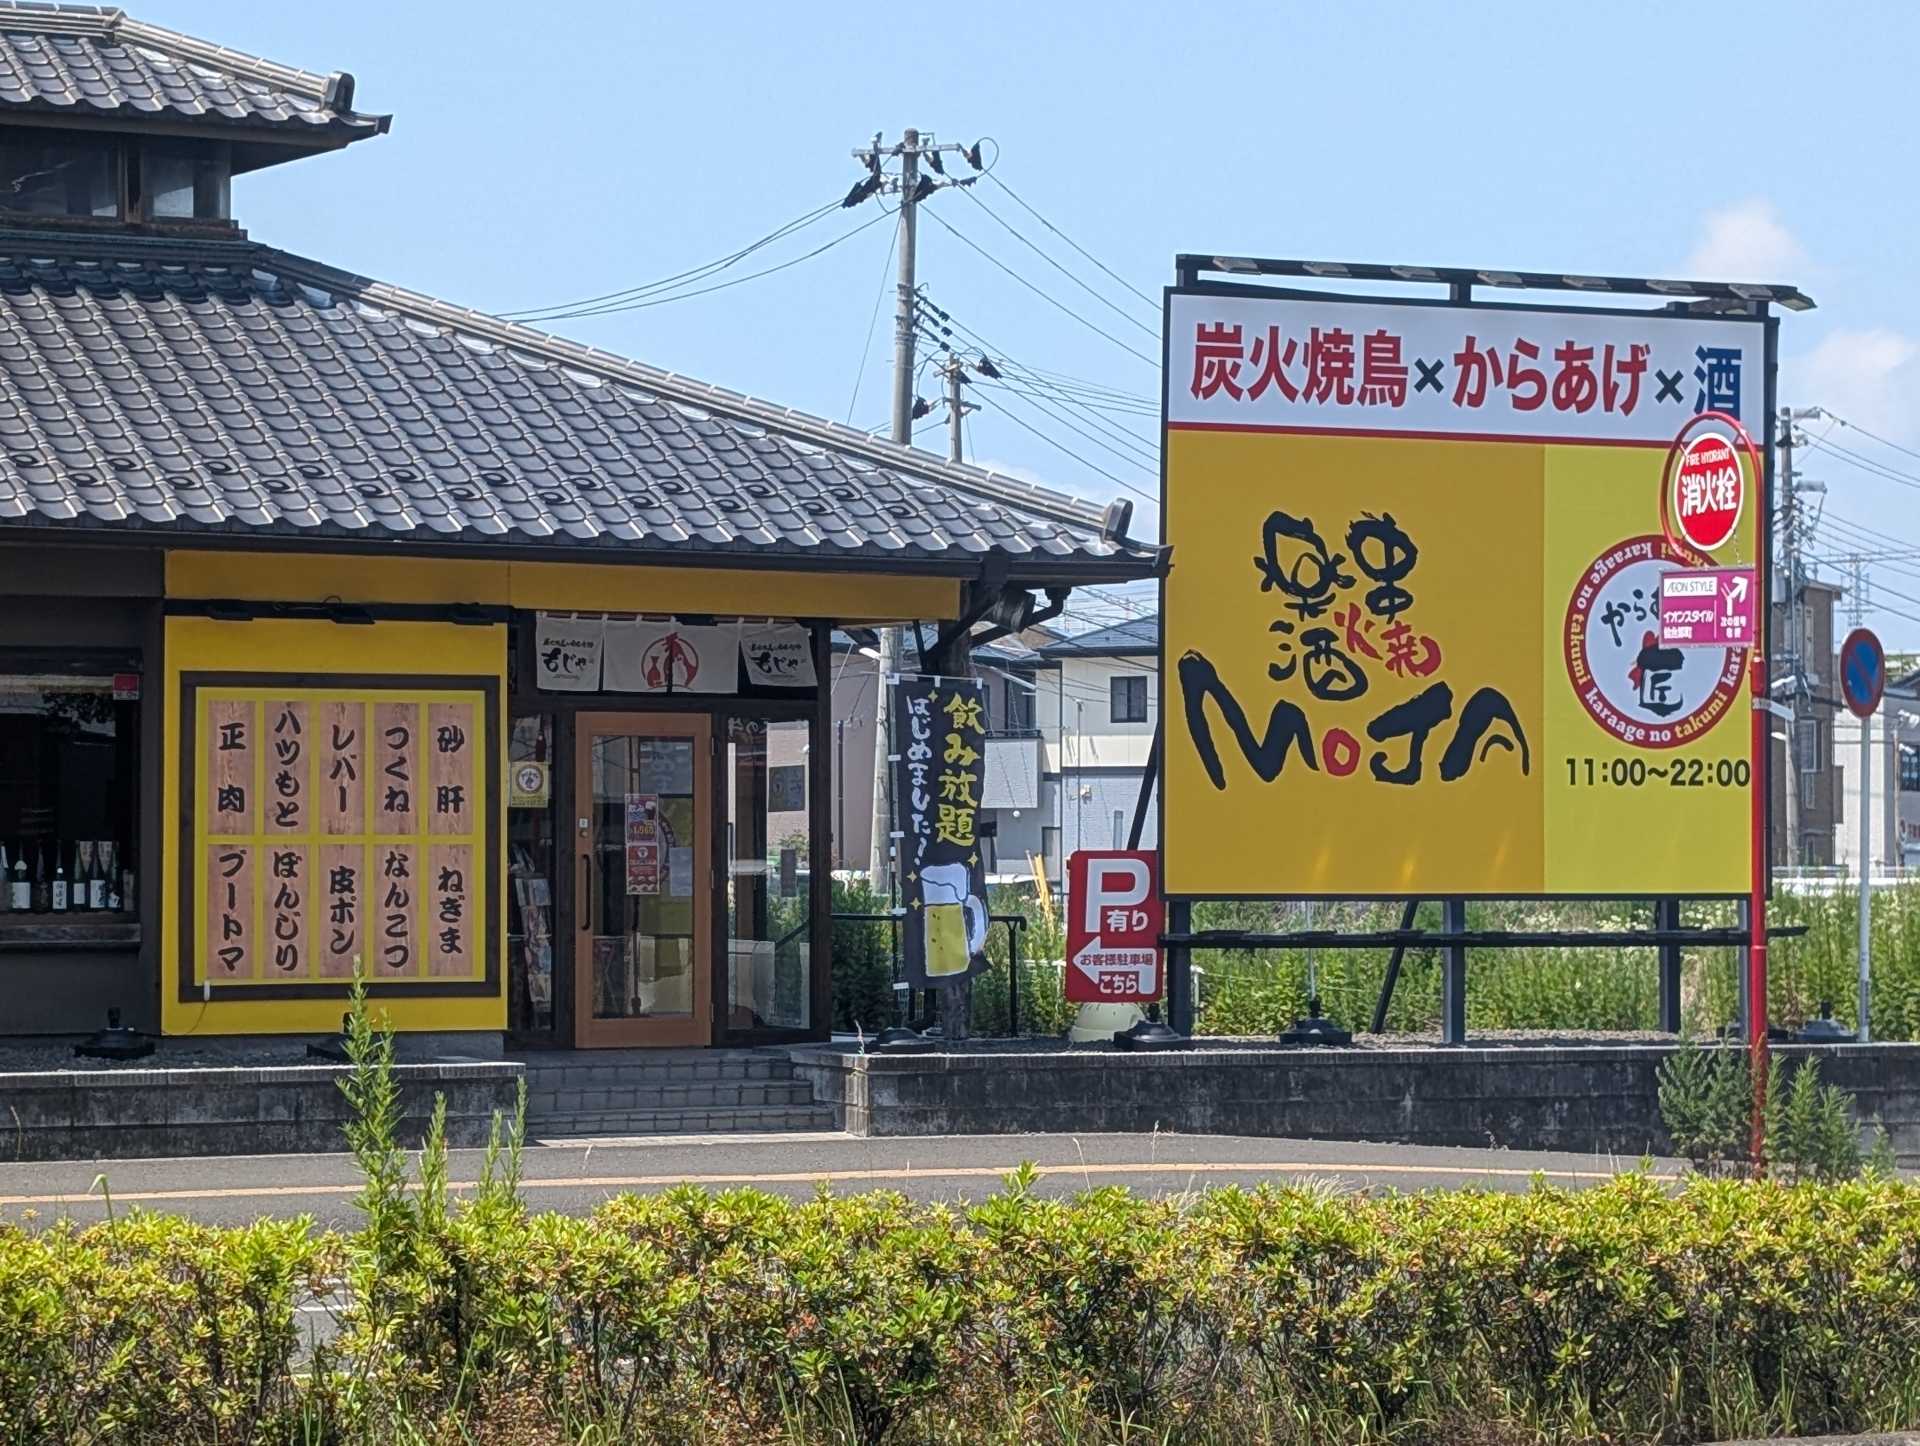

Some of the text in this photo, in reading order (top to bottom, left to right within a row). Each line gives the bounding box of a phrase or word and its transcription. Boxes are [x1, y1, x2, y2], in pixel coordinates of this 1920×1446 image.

[1681, 466, 1737, 517] 消火栓
[1577, 584, 1594, 610] no
[1590, 542, 1654, 585] karaage
[1689, 581, 1713, 592] STYLE
[1570, 613, 1591, 686] takumi
[1584, 687, 1646, 742] karaage
[1649, 730, 1672, 742] no
[1674, 690, 1729, 739] takumi
[217, 722, 247, 813] 正肉
[274, 710, 302, 828] ハツもと
[329, 724, 357, 812] レバー
[384, 726, 410, 813] つくね
[436, 725, 465, 813] 砂肝
[934, 693, 986, 847] 飲み放題
[273, 851, 302, 971] ぼんじり
[329, 866, 357, 955] 皮ポン
[384, 851, 410, 968] なんこつ
[438, 866, 465, 954] ねぎま
[1085, 858, 1151, 933] P
[1107, 909, 1149, 933] 有り
[1079, 953, 1154, 966] お客様駐車場
[1100, 974, 1138, 994] こちら
